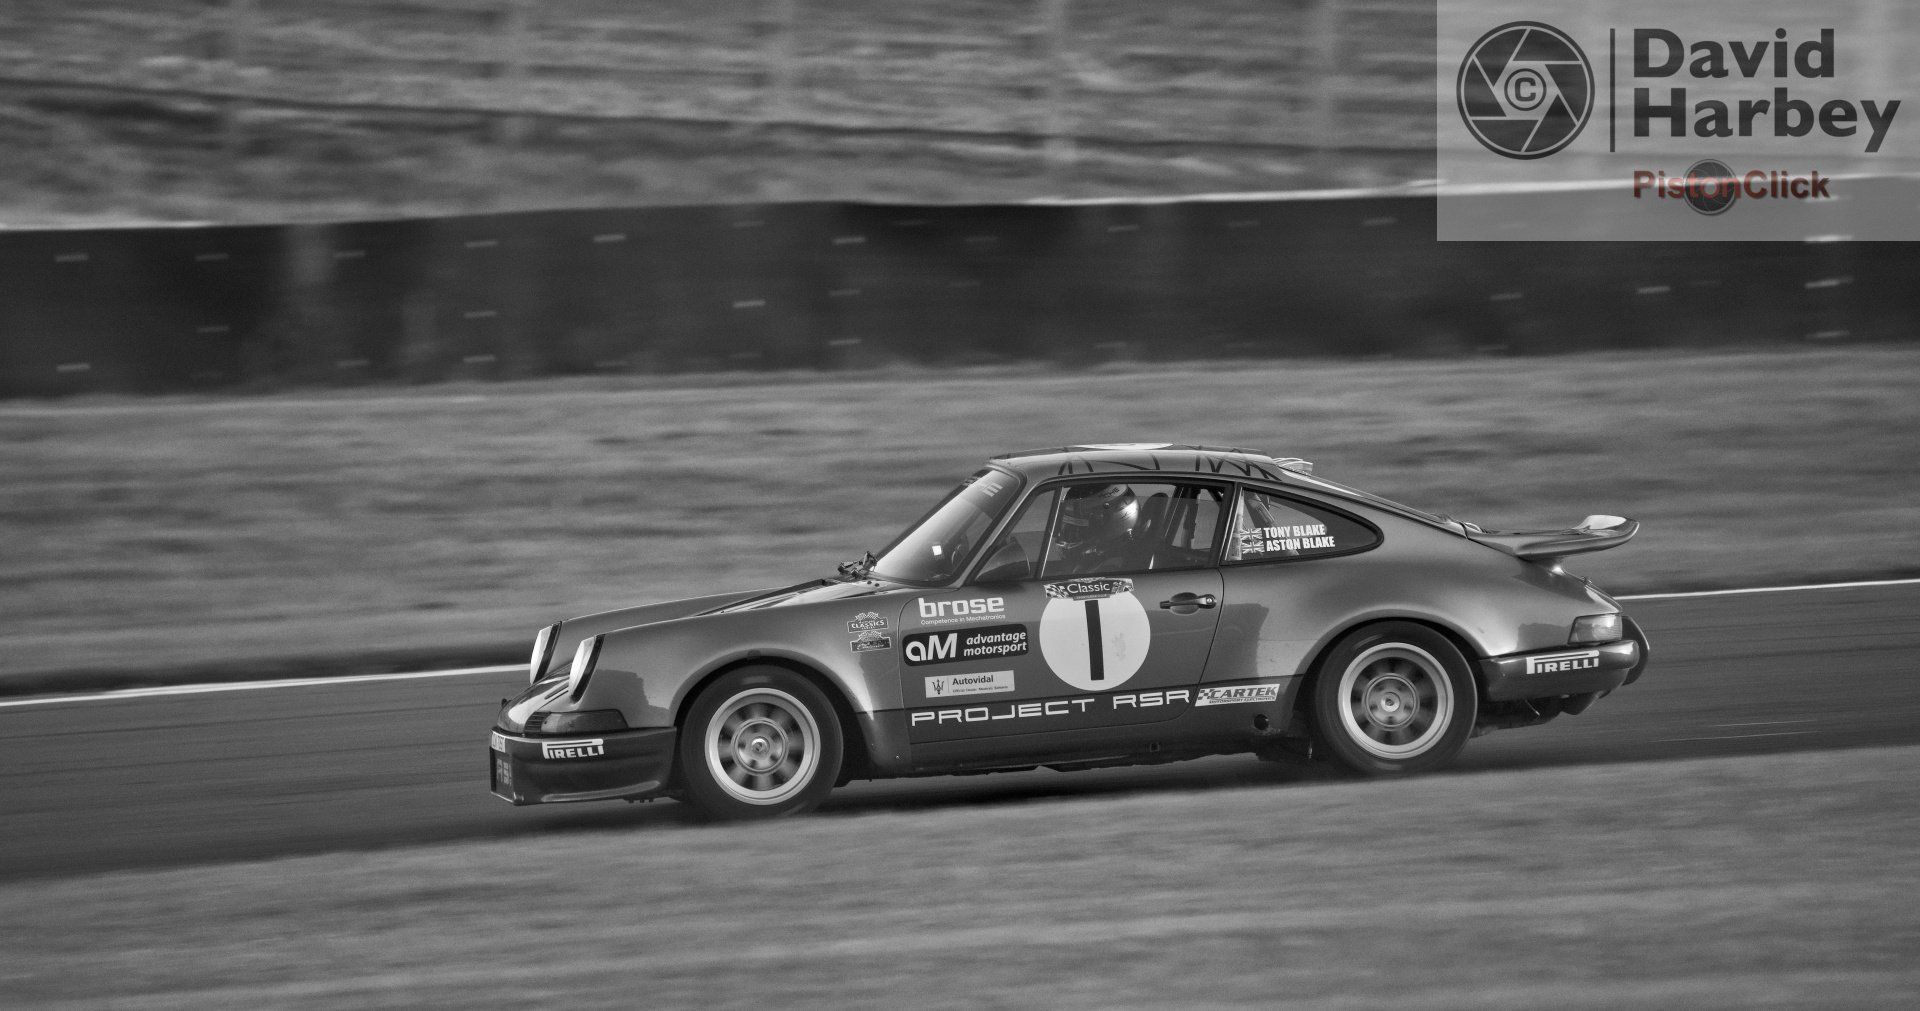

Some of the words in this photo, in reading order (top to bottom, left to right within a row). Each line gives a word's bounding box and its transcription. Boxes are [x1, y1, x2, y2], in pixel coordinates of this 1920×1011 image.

[1263, 526, 1290, 538] TONY
[1293, 524, 1326, 536] BLAKE
[1266, 539, 1301, 551] ASTON
[1302, 536, 1335, 549] BLAKE
[1067, 583, 1110, 593] Classic
[918, 597, 1004, 617] brose
[851, 620, 885, 629] CLASSICS
[966, 631, 1027, 645] advantage
[1085, 600, 1104, 680] 1
[963, 642, 1027, 656] motorsport
[1526, 650, 1599, 674] PIRELLI
[952, 675, 994, 686] Autovidal
[1210, 687, 1277, 699] CARTEK
[911, 699, 1095, 726] PROJECT
[1112, 690, 1189, 709] RSR
[542, 738, 604, 759] PIRELLI
